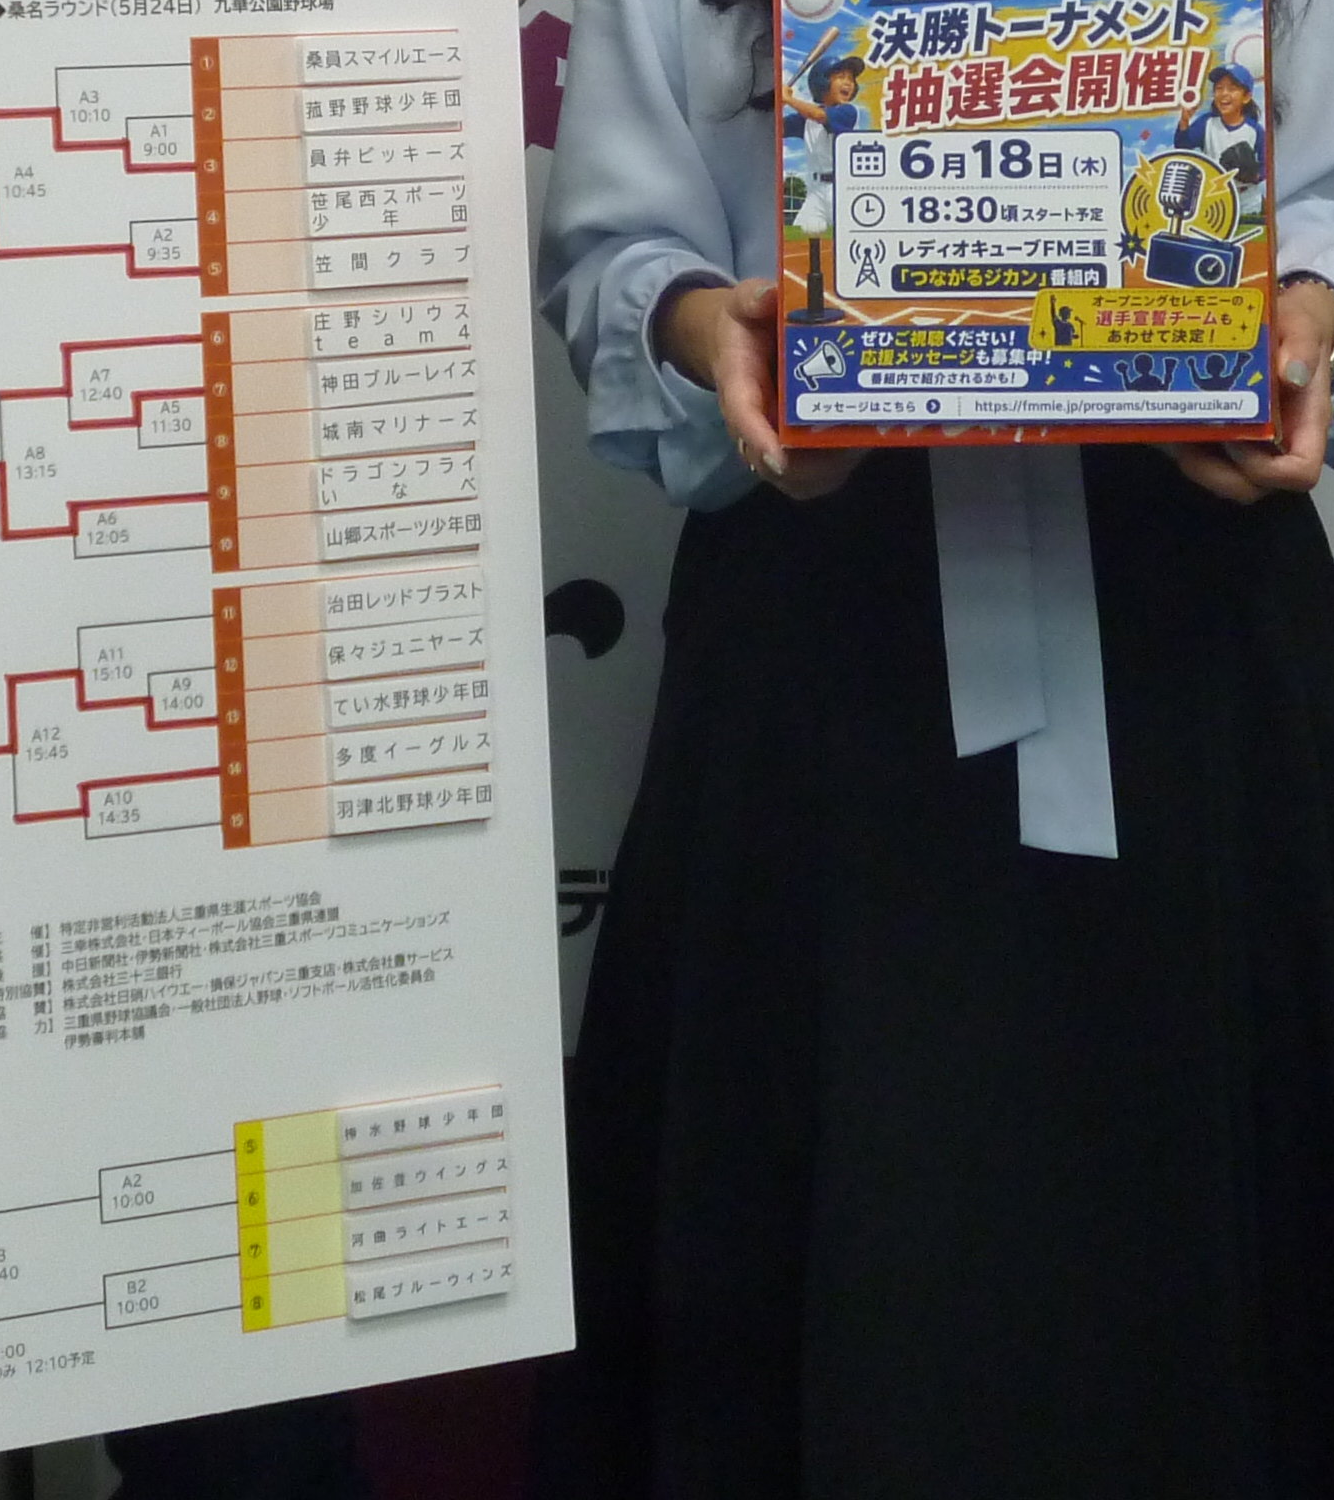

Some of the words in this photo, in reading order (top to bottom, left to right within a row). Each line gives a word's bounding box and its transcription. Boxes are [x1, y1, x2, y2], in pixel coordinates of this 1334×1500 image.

[70, 108, 110, 123] 10:10
[899, 139, 1063, 180] 6月18日
[3, 183, 47, 198] 10:45
[1022, 206, 1104, 223] スタート予定
[147, 246, 181, 261] 9:35
[898, 238, 1107, 259] レディオキューブFM三重
[315, 244, 471, 274] 笠間クラブ
[1092, 294, 1244, 307] オープニングセレモニーの
[1095, 310, 1233, 326] 選手宣誓チームも
[321, 358, 477, 394] 神田ブルーレイズ
[812, 401, 916, 413] メッセージはこちら
[322, 408, 478, 441] 城南マリナーズ
[321, 454, 475, 485] ドラゴンフライ
[326, 512, 482, 547] 山郷スポーツ少年団
[92, 665, 133, 681] 15:10
[334, 678, 489, 716] てい水野球少年団
[337, 784, 493, 819] 羽津北野球少年団
[111, 1190, 155, 1210] 10:00
